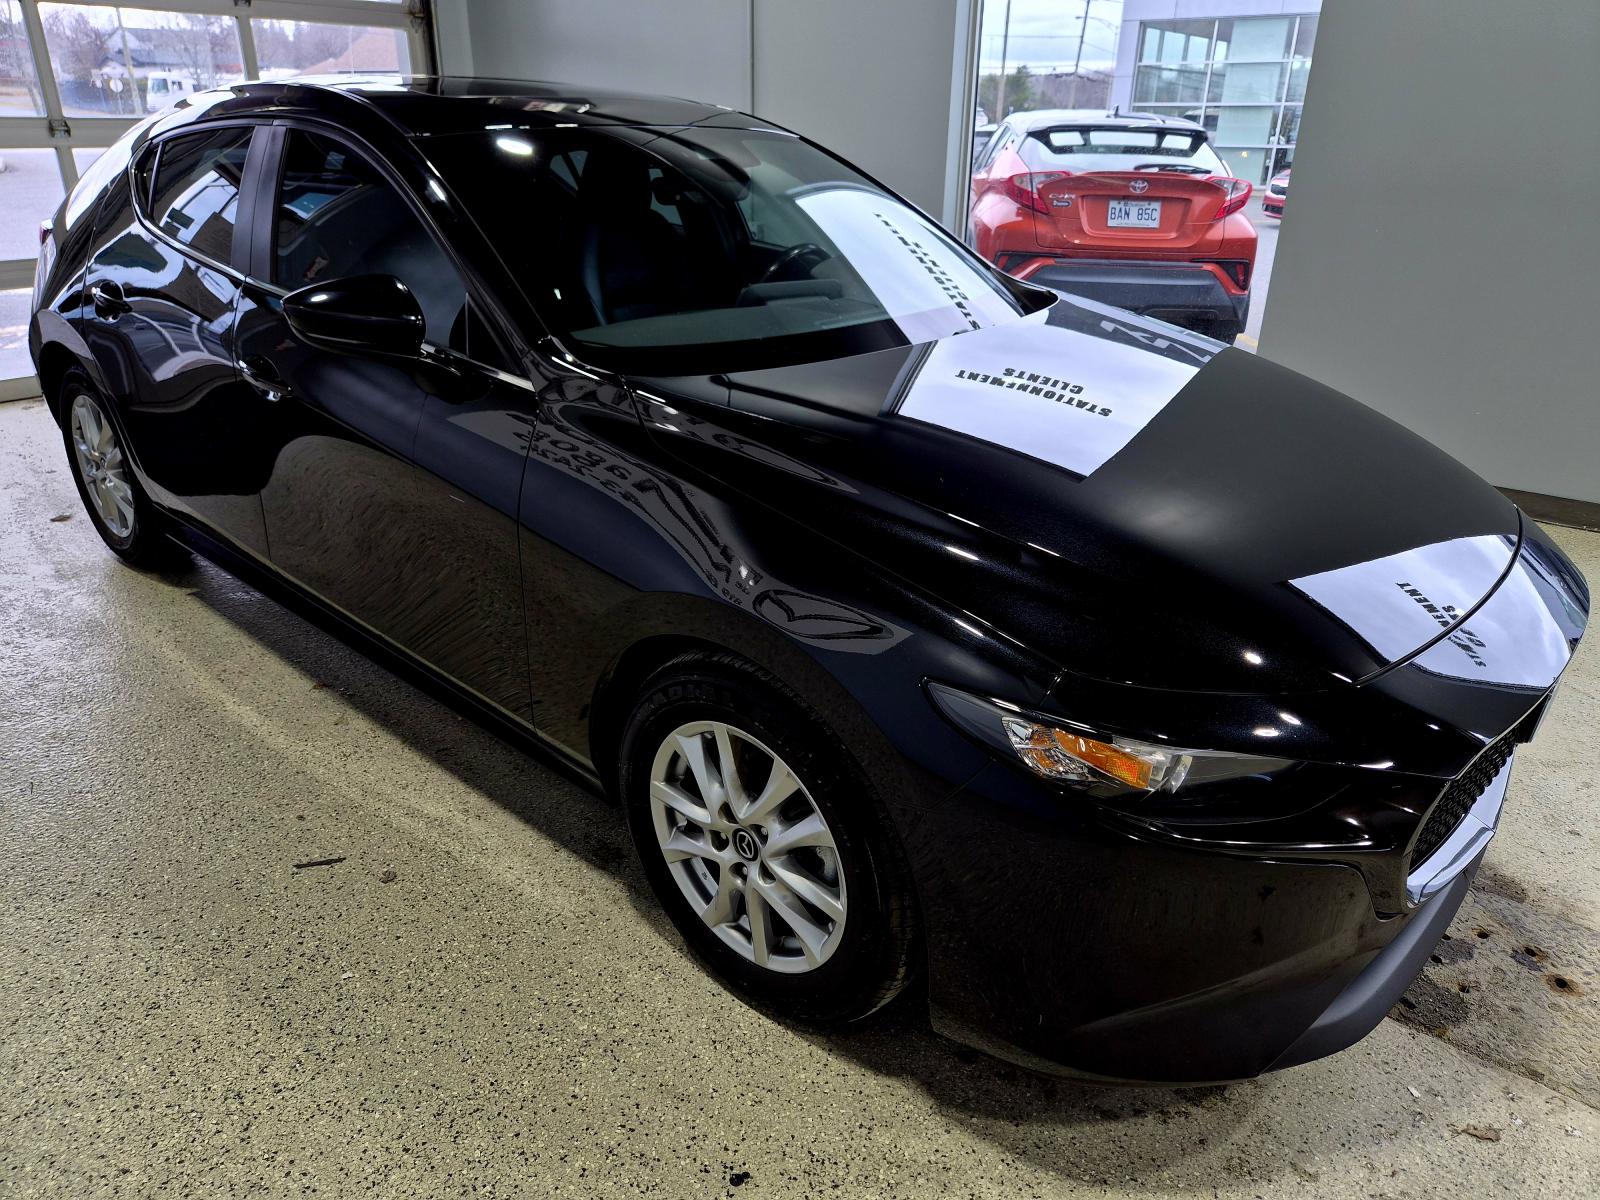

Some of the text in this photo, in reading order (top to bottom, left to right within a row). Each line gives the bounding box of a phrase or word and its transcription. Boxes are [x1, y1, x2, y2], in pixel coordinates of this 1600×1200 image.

[1110, 207, 1130, 220] BAN
[955, 369, 1112, 417] STATIONNEMENT
[1003, 367, 1084, 395] CLIENTS
